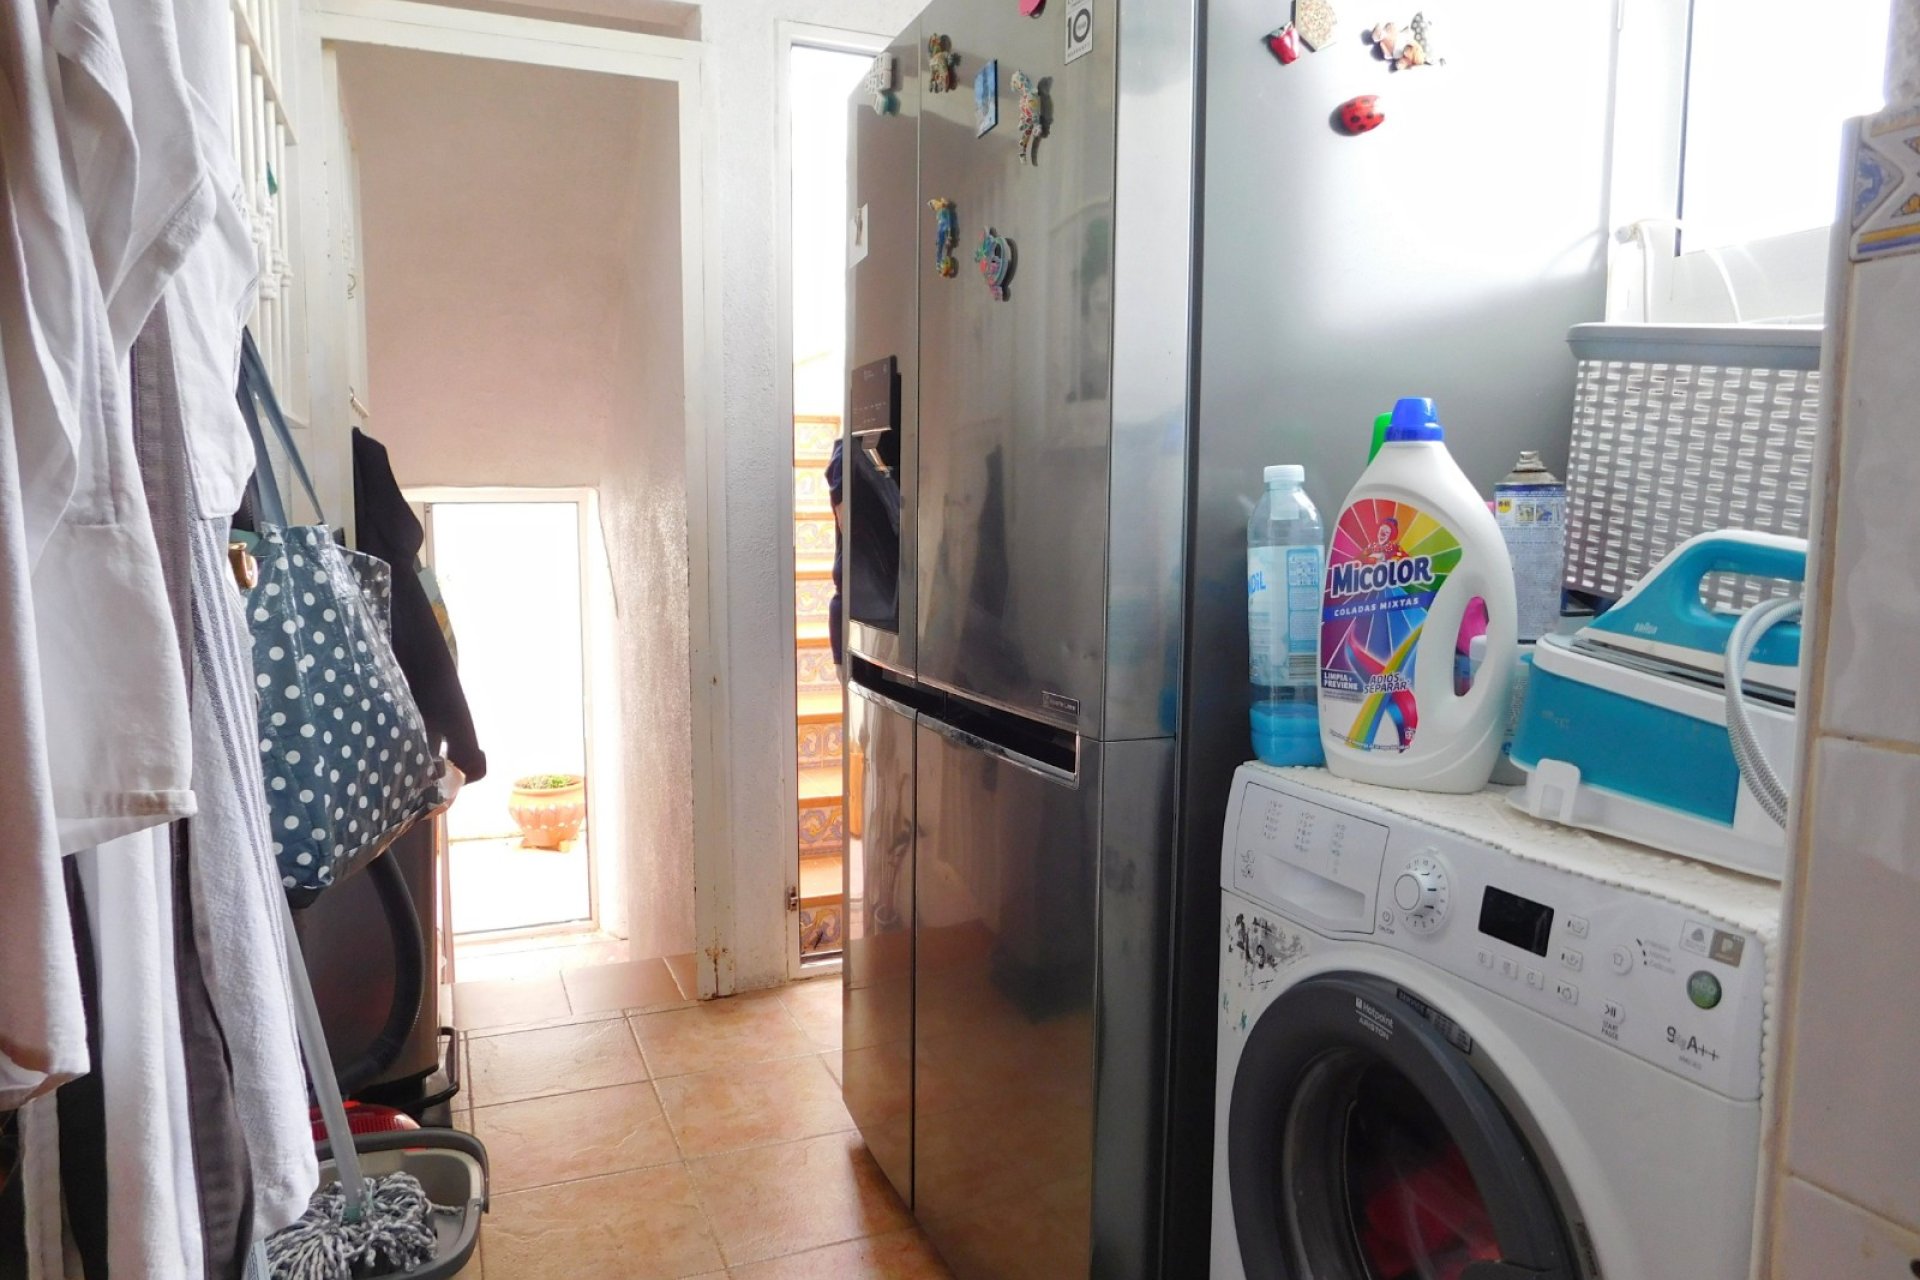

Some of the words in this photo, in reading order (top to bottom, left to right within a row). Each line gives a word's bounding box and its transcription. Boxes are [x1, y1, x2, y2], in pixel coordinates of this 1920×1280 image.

[1067, 8, 1091, 49] 10
[1334, 603, 1376, 617] COLADAS
[1380, 597, 1419, 610] MIXTAS
[1364, 681, 1407, 694] SEPARAR
[1363, 1001, 1393, 1029] Hotpoint
